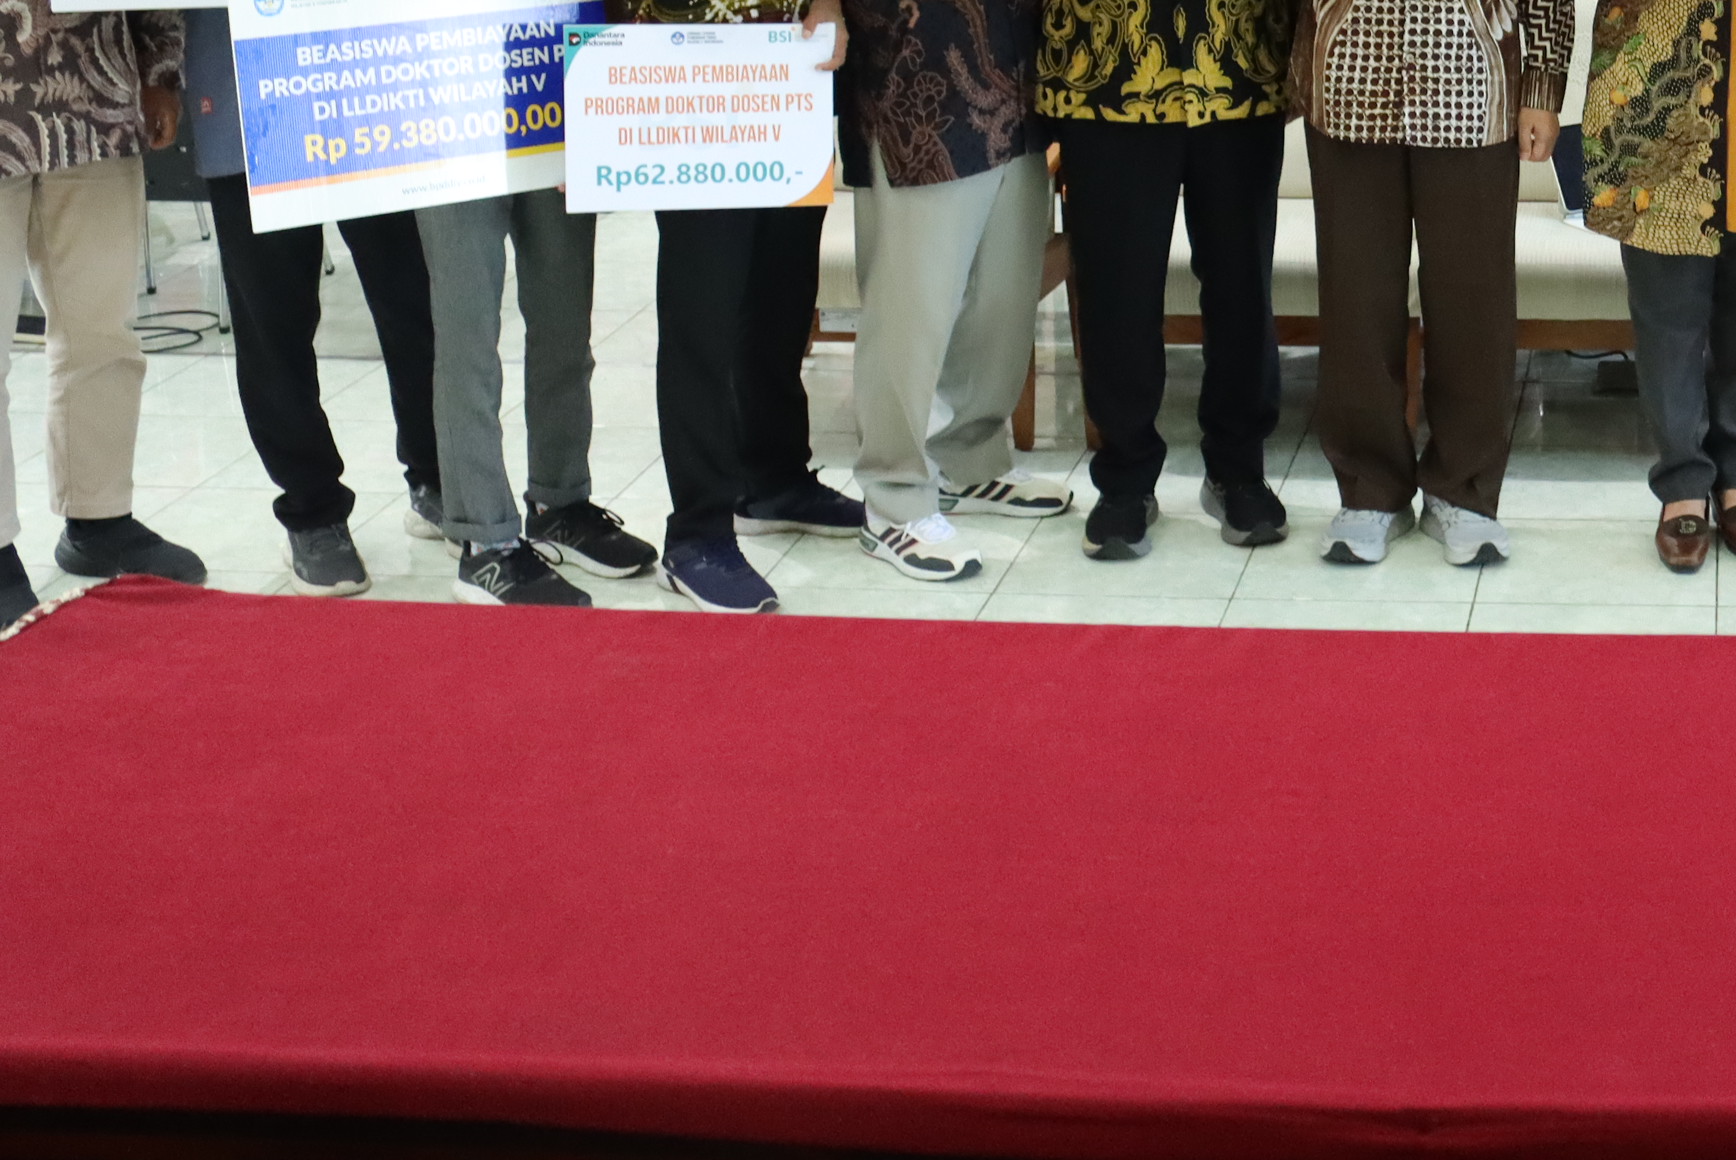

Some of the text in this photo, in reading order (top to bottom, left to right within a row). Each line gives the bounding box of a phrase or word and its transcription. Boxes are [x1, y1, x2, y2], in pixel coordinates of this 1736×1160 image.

[297, 20, 555, 66] BEASISWA PEMBIAYAAN
[584, 31, 624, 39] Danantara
[768, 31, 792, 43] BSI
[259, 68, 376, 99] PROGRAM
[381, 58, 472, 87] DOKTOR
[479, 49, 550, 71] DOSEN
[609, 64, 789, 84] BEASISWA PEMBIAYAAN
[313, 73, 546, 121] DI LLDIKTI WILAYAH V
[585, 93, 813, 115] PROGRAM DOKTOR DOSEN PTS
[305, 102, 562, 164] Rp 59.380.000,00
[619, 124, 781, 145] DI LLDIKTI WILAYAH V
[597, 161, 802, 192] Rp62.880.000,-
